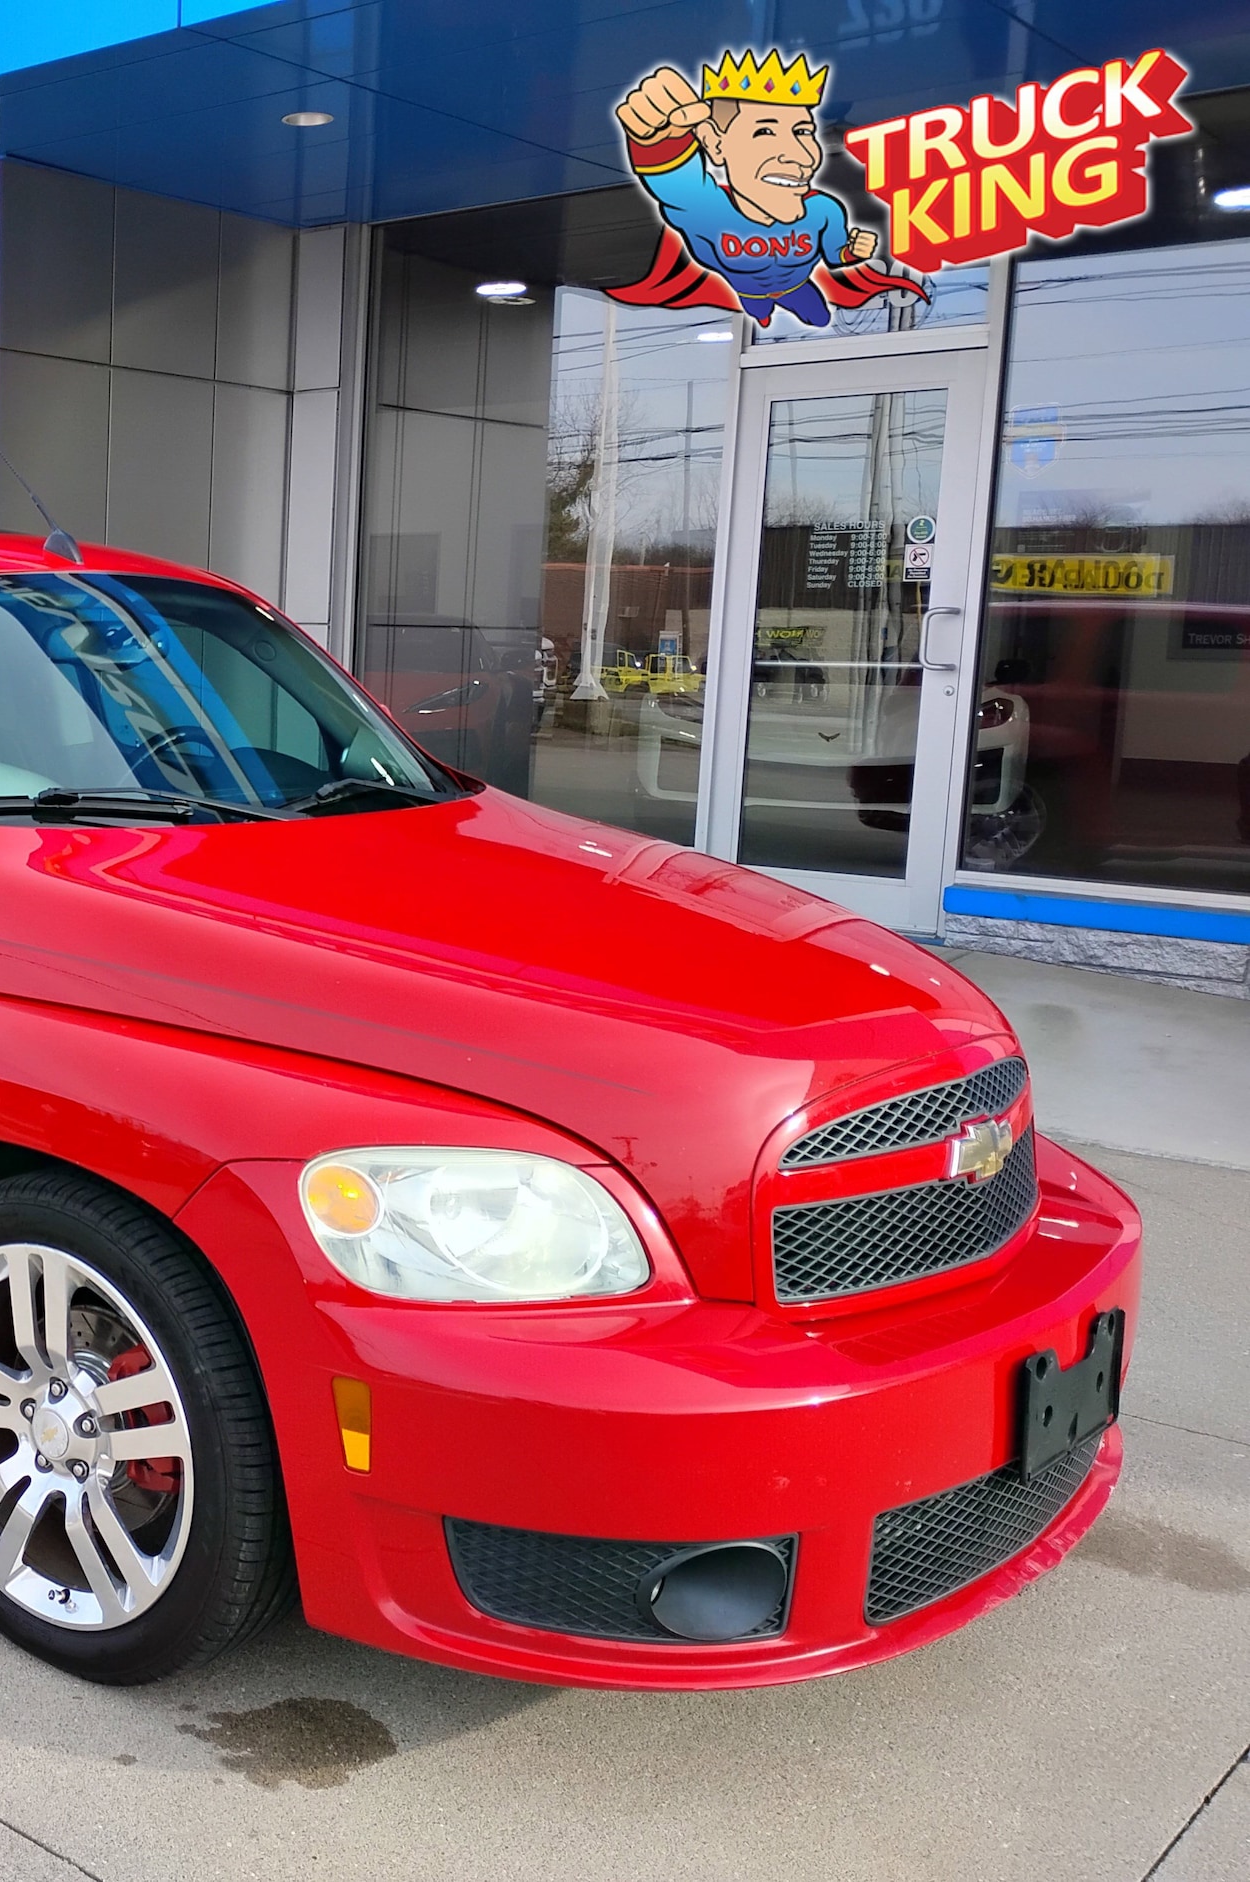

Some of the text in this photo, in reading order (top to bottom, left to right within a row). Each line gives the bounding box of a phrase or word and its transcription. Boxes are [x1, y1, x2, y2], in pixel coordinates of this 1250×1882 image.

[814, 520, 886, 532] SALES HOURS
[810, 542, 837, 550] Tuesday
[809, 549, 848, 557] Wednesday
[809, 558, 839, 566] Thursday
[808, 565, 829, 574] Friday
[807, 573, 837, 581] Saturday
[806, 580, 883, 589] Sunday CLOSED
[1188, 633, 1232, 645] TREVOR
